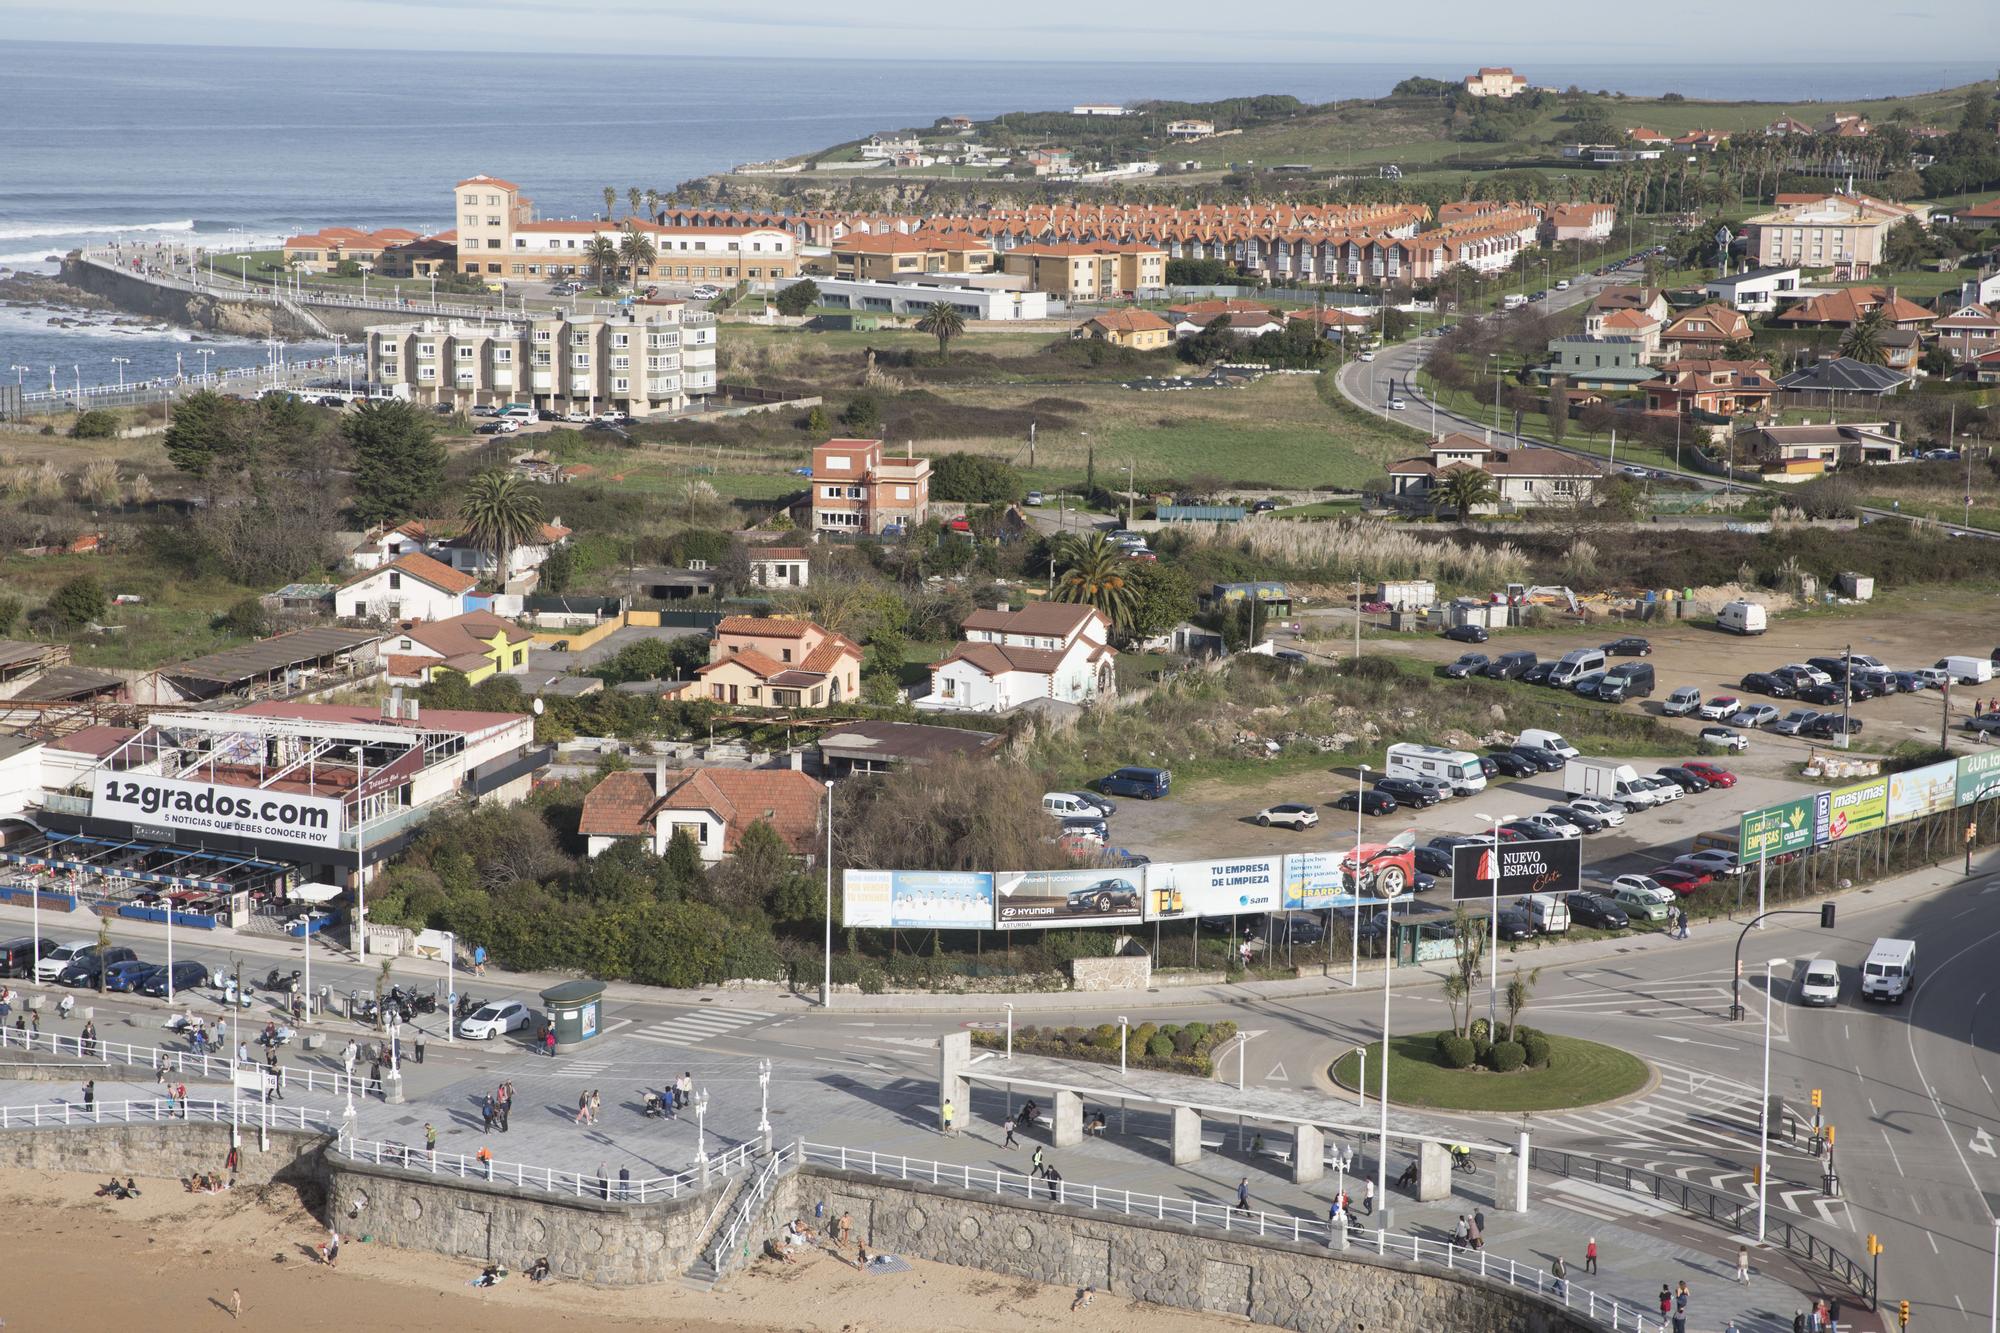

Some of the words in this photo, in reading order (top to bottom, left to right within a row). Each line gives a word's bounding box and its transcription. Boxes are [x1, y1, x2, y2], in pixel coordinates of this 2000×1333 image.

[105, 780, 329, 829] 12grados.com
[1834, 785, 1885, 809] masymas
[164, 813, 170, 822] 5
[171, 814, 212, 828] NOTICIAS
[214, 820, 233, 830] QUE
[234, 822, 262, 834] DEBES
[264, 826, 307, 841] CONOCER
[308, 832, 328, 842] HOY
[1748, 829, 1780, 850] EMPESAS
[1503, 850, 1541, 864] NUEVO
[1212, 866, 1224, 876] TU
[1226, 863, 1270, 875] EMPRESA
[1503, 862, 1548, 877] ESPACIO
[1212, 878, 1224, 887] DE
[1226, 875, 1270, 886] LIMPIEZA
[1288, 882, 1342, 900] GERARDO
[1250, 896, 1269, 904] sam
[1018, 907, 1055, 915] HYUNDAI
